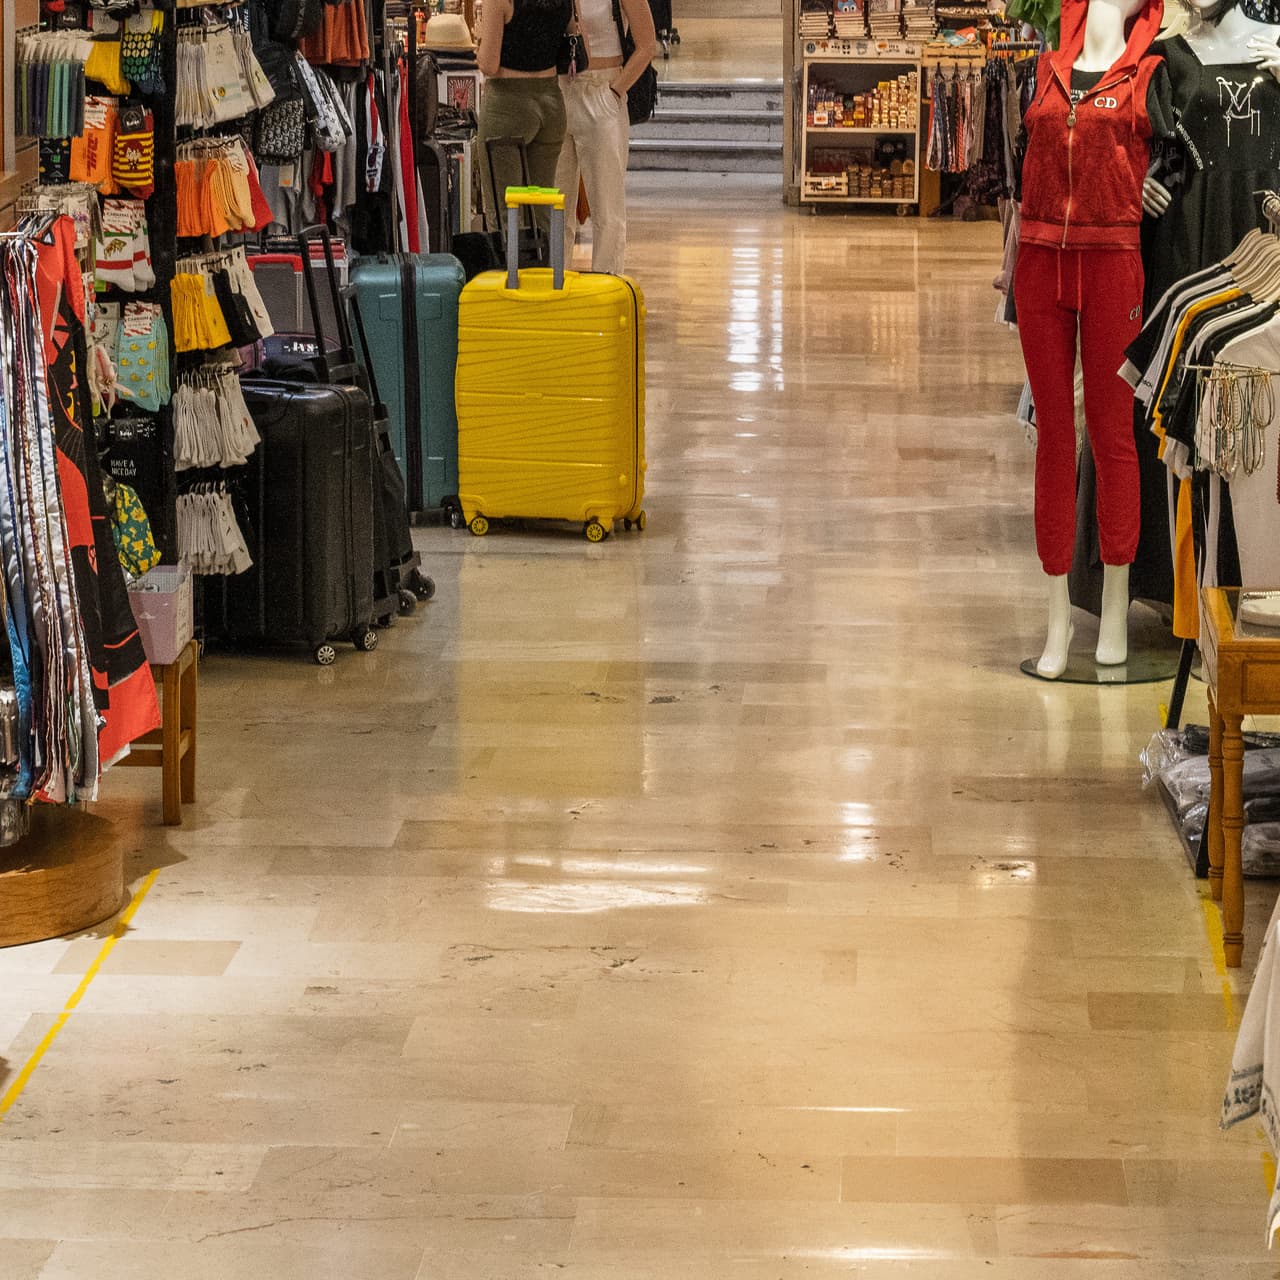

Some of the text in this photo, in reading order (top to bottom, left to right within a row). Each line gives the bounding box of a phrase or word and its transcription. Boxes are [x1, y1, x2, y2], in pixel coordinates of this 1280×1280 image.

[1094, 97, 1117, 108] CD
[1129, 305, 1140, 320] CD
[110, 459, 134, 468] HAVE A
[124, 468, 137, 476] DAY
